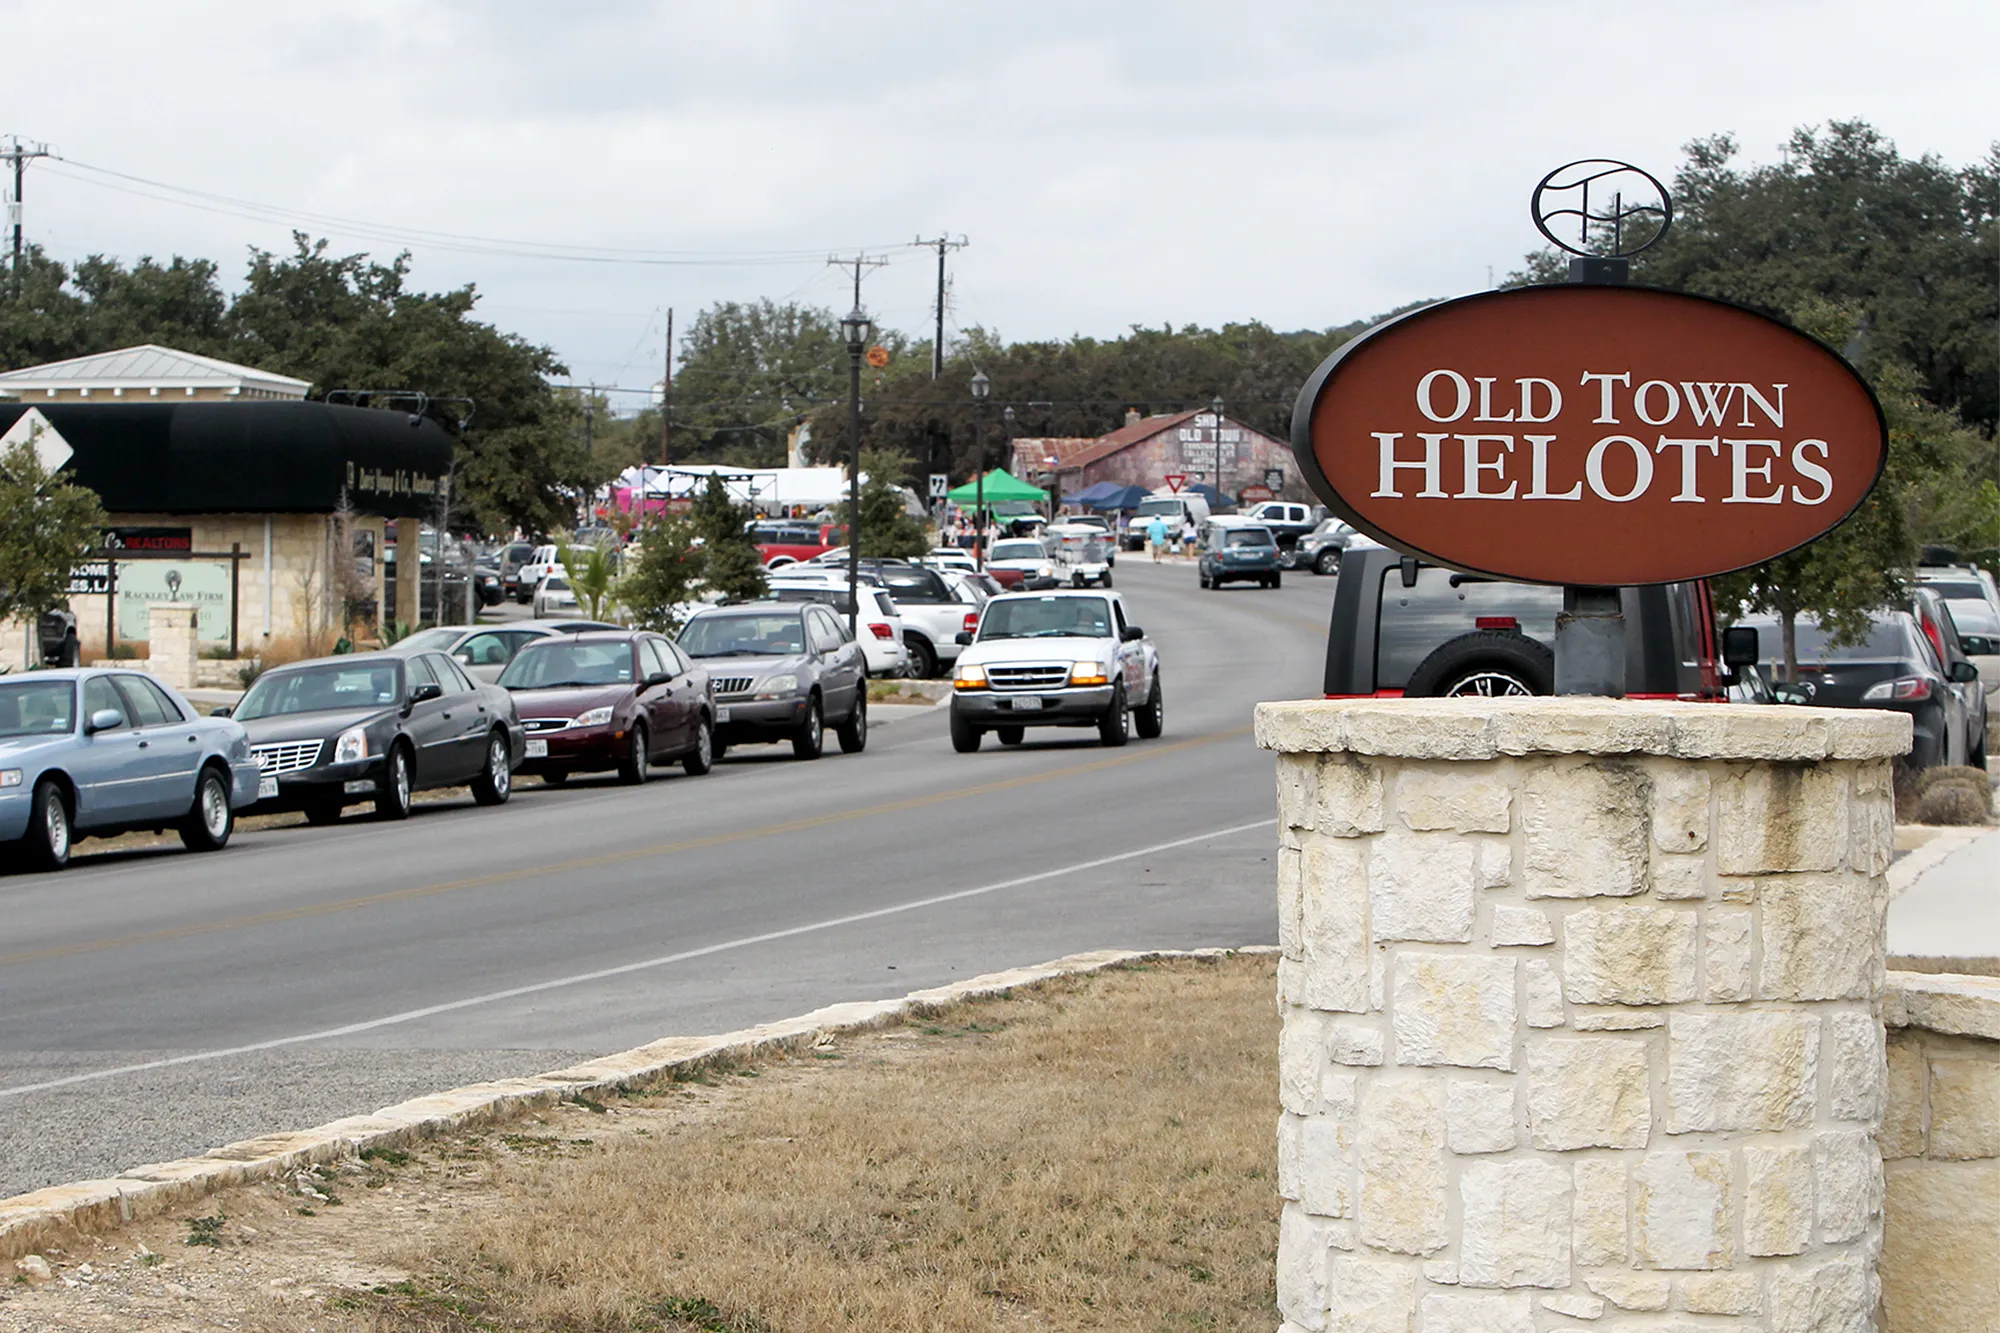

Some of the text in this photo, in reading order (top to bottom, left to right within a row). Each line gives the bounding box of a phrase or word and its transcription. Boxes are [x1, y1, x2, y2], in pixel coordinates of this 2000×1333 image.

[1416, 368, 1788, 429] OLD TOWN
[1179, 428, 1202, 442] OLD
[1370, 431, 1834, 506] HELOTES
[126, 537, 189, 549] REALTORS
[124, 590, 170, 600] RACKLEY
[198, 590, 224, 601] FIRM
